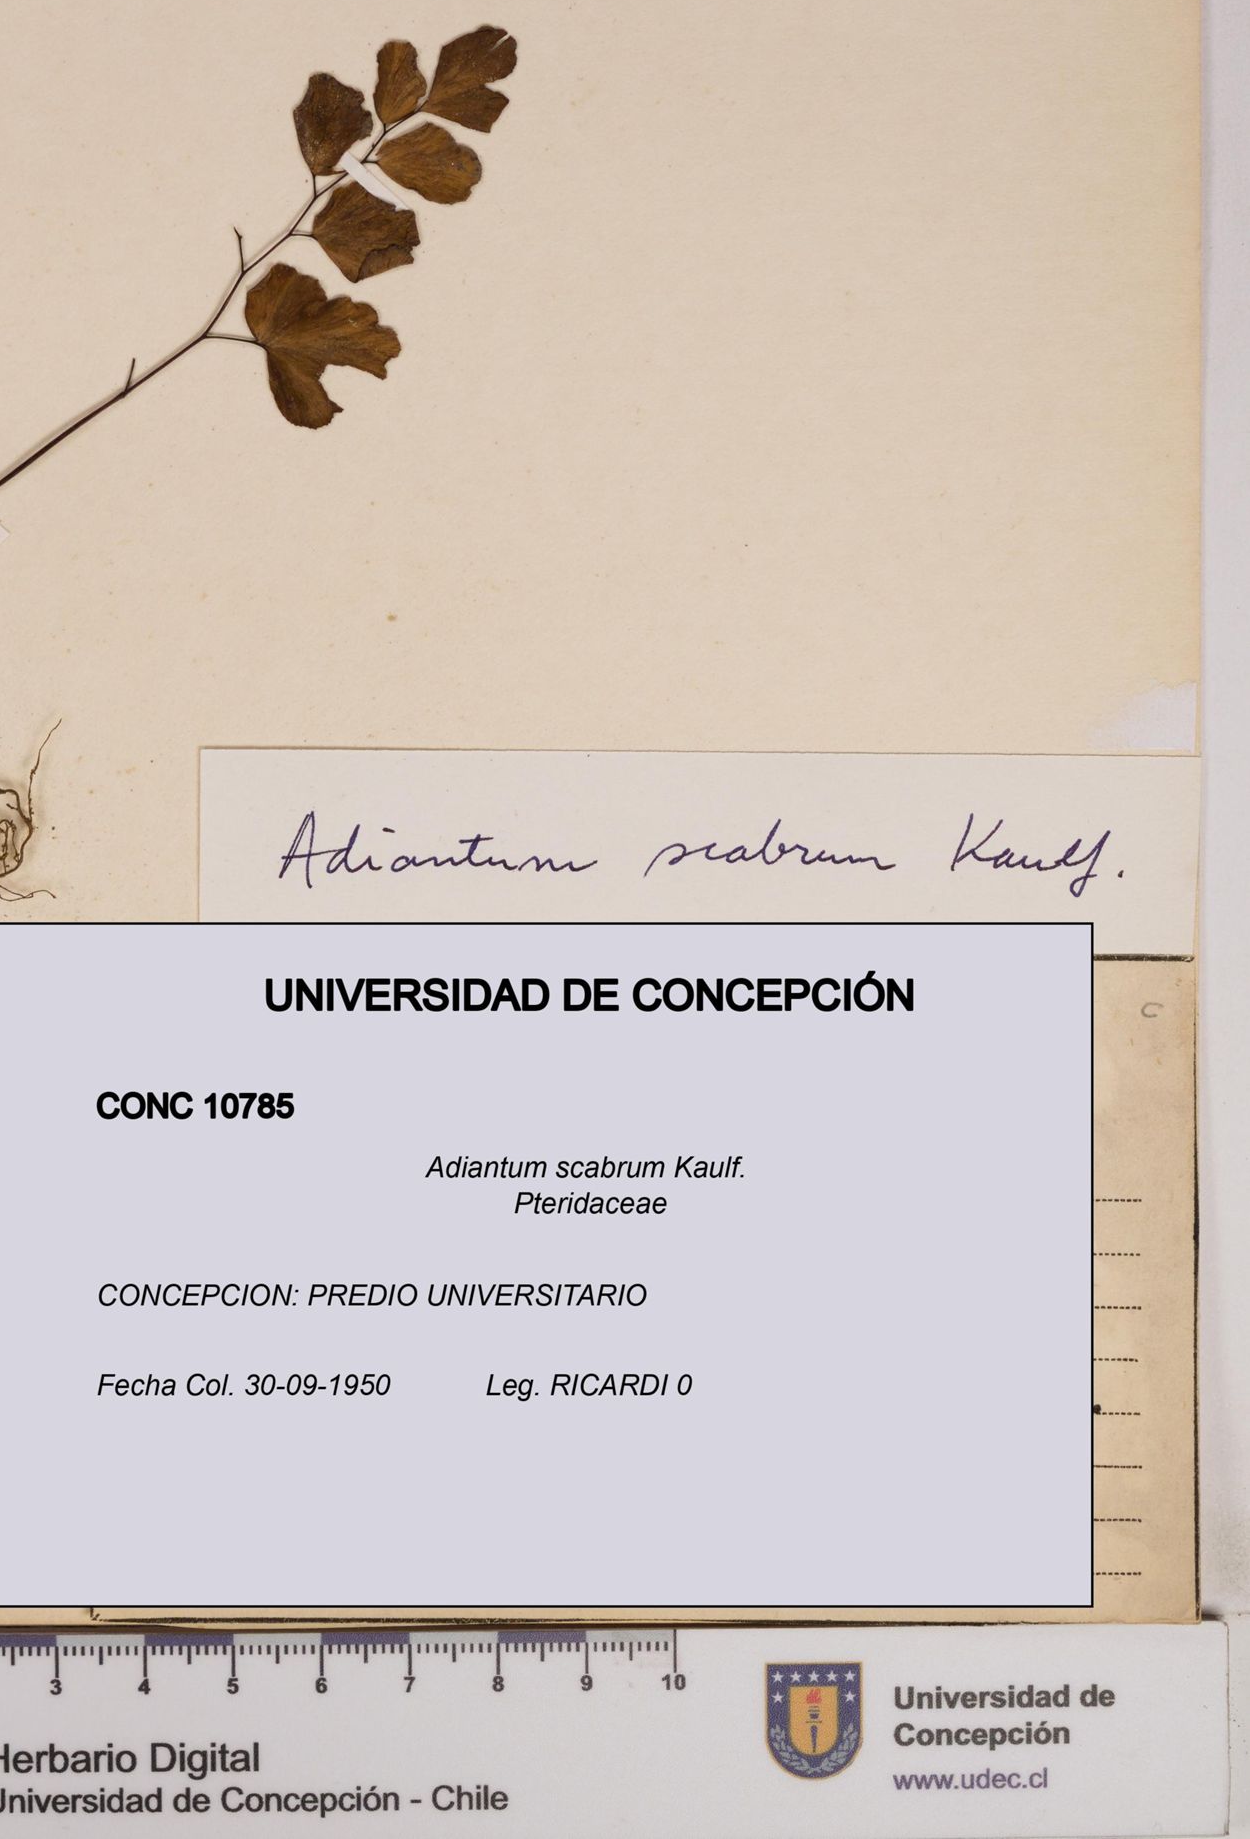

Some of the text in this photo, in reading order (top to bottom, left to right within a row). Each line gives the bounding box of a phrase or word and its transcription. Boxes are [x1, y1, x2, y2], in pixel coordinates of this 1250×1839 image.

[278, 810, 598, 890] Adiantum
[643, 818, 897, 877] scabrum
[49, 1677, 63, 1696] 3
[137, 1677, 152, 1696] 4
[226, 1676, 240, 1695] 5
[315, 1675, 328, 1694] 6
[403, 1674, 416, 1693] 7
[492, 1674, 505, 1693] 8
[580, 1673, 593, 1692] 9
[661, 1673, 686, 1691] 10
[894, 1683, 1116, 1710] Universidad de
[893, 1720, 1071, 1752] Concepción
[150, 1741, 260, 1781] Digital
[892, 1766, 1049, 1791] www.udec.cl
[172, 1786, 211, 1814] de
[220, 1785, 400, 1819] Concepción
[431, 1784, 509, 1813] Chile
